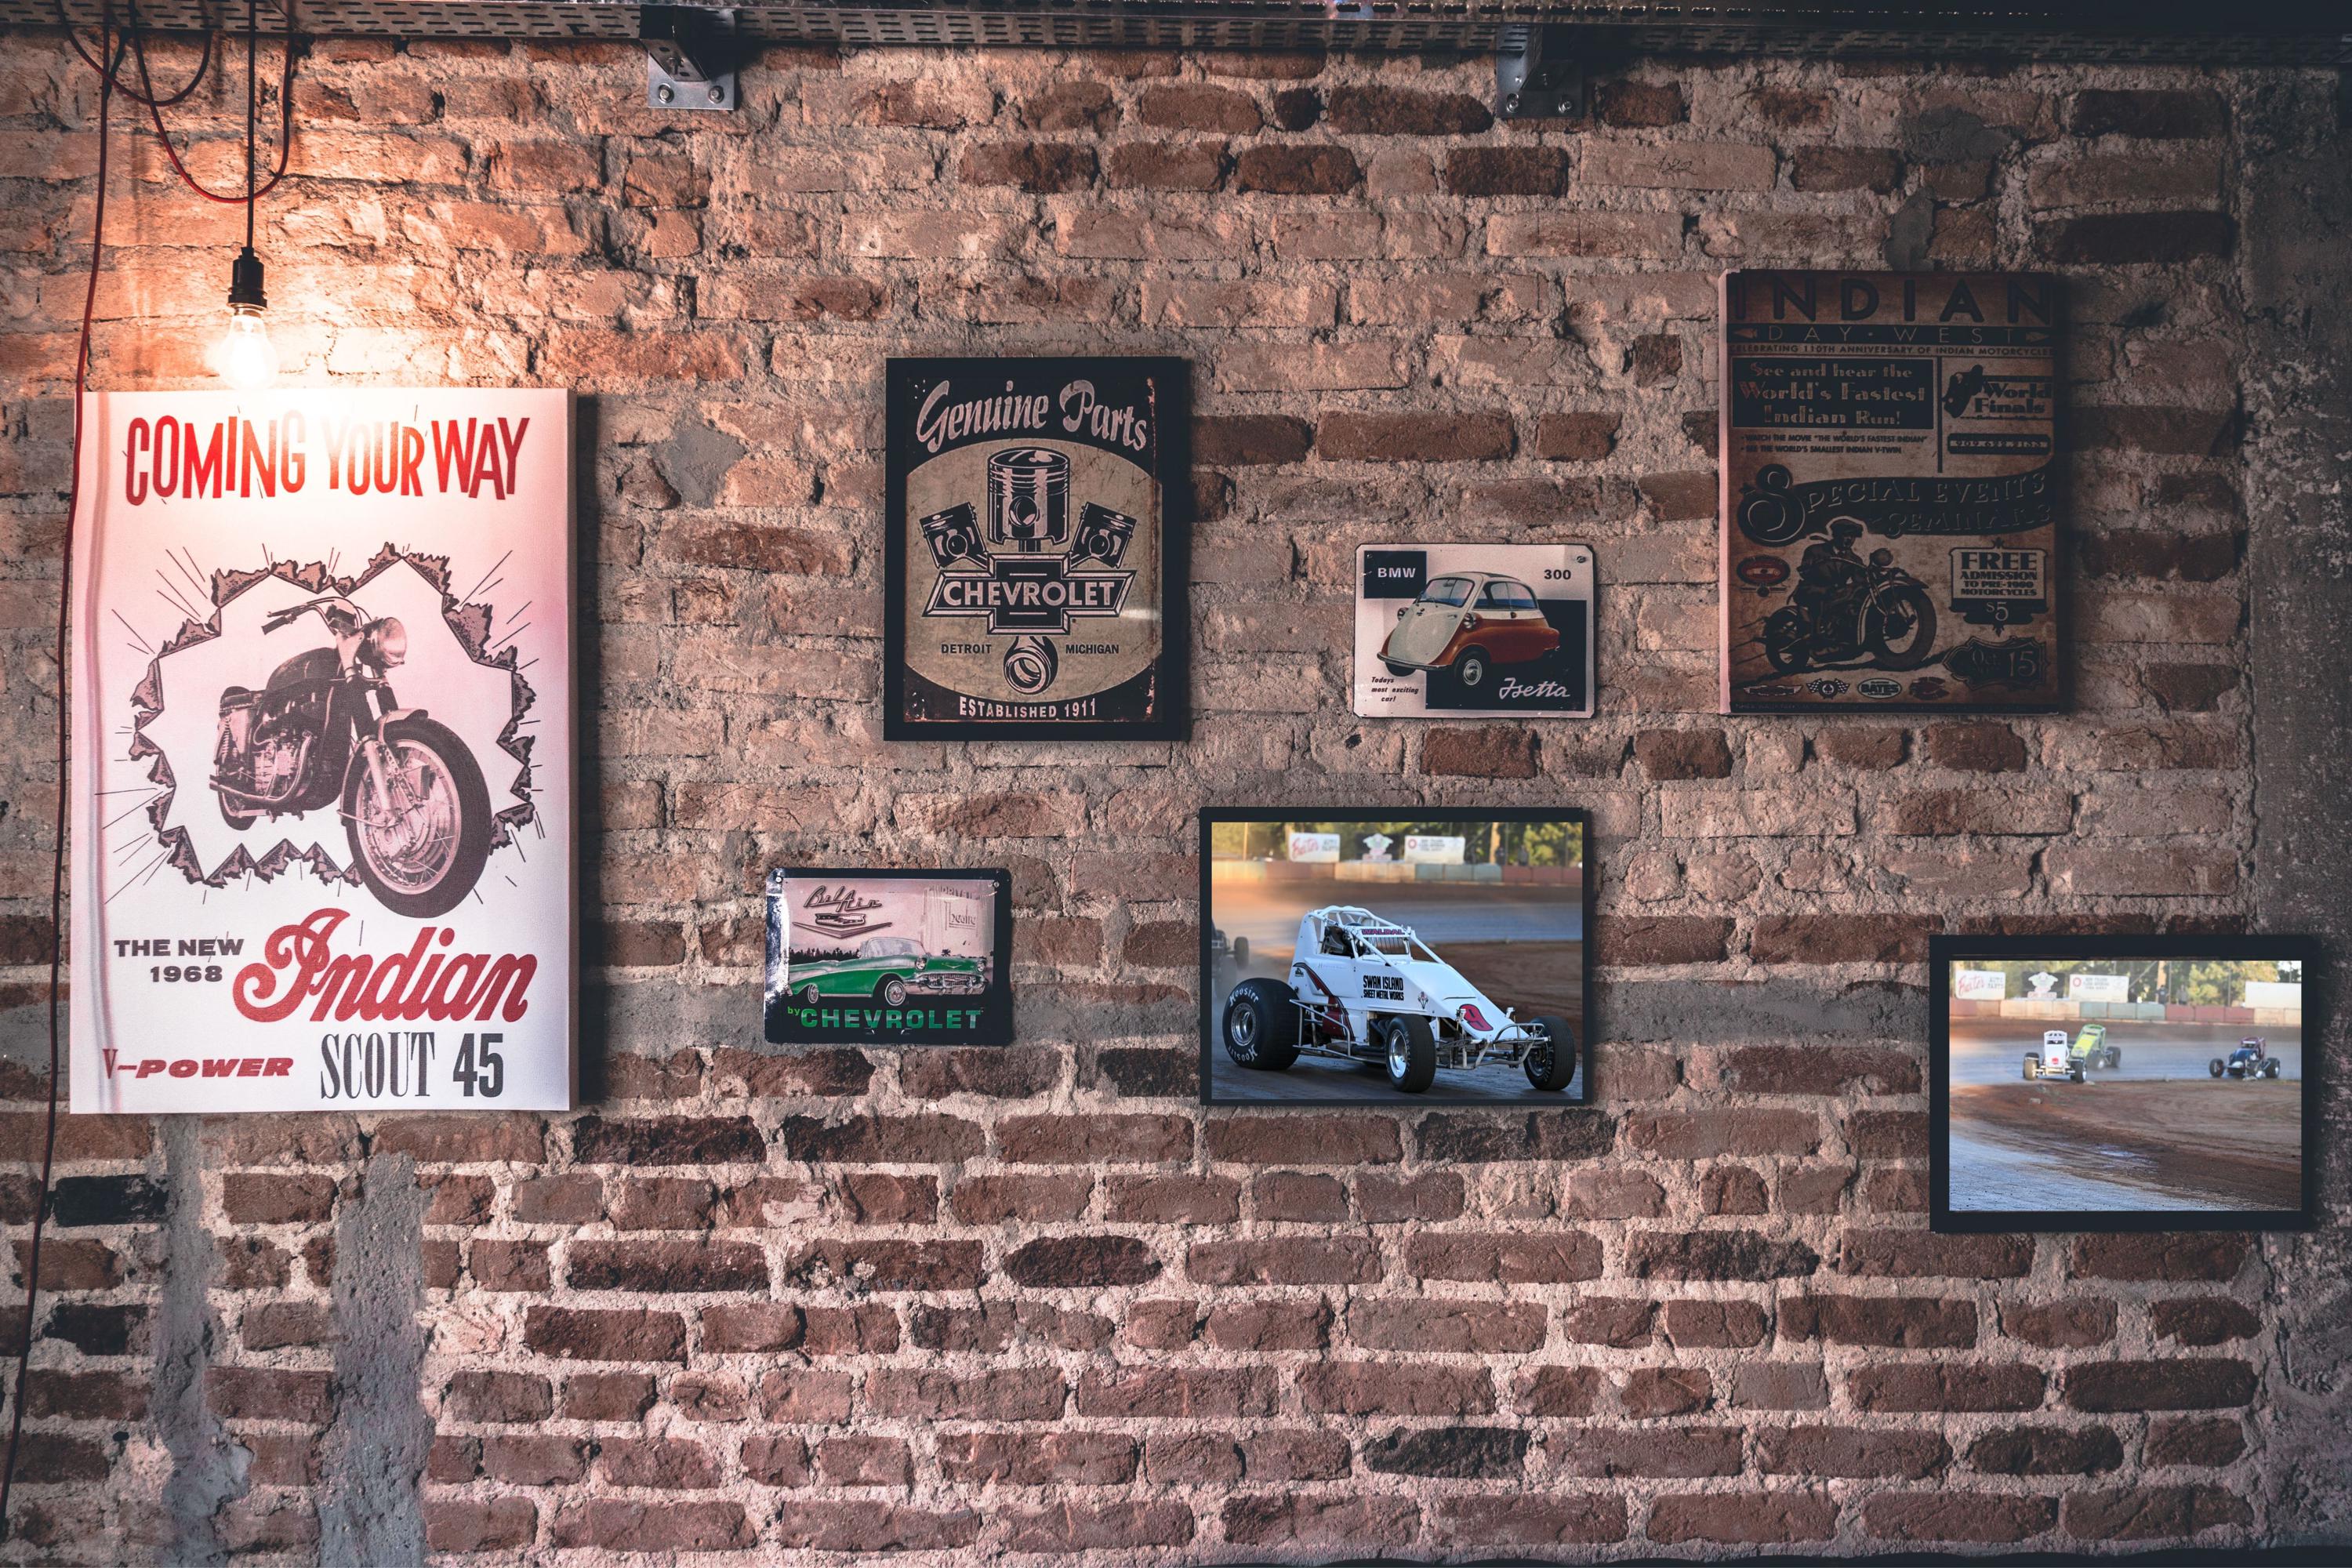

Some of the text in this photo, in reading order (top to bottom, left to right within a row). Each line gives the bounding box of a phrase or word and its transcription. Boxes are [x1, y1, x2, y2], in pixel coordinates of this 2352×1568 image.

[1734, 277, 2053, 323] INDIAN
[1769, 325, 2014, 344] DAY WEST
[1804, 345, 1835, 354] 110TH
[1841, 346, 1913, 354] ANNIVERSARY
[1750, 361, 1913, 378] See and hear the
[1738, 380, 1926, 401] World's Fastest
[1982, 383, 2053, 398] World
[1763, 404, 1901, 426] Indian Run!
[1974, 397, 2045, 413] Finals
[916, 379, 1147, 454] Genuine Parts
[1744, 434, 1771, 442] WATCH
[1773, 434, 1786, 442] THE
[1832, 434, 1865, 443] WORLD'S
[125, 408, 531, 506] COMING YOUR WAY
[1875, 446, 1902, 455] V-TWIN
[1738, 464, 2047, 546] SPECIAL EVENTS
[1888, 503, 2053, 540] SEMINARS
[1960, 551, 2038, 571] FREE
[1377, 567, 1416, 579] BMW
[1543, 568, 1572, 580] 300
[1960, 571, 2038, 581] ADMISSION
[942, 580, 1116, 607] CHEVROLET
[941, 643, 1120, 655] DETROIT MICHIGAN
[2009, 651, 2037, 677] 15
[1392, 686, 1420, 695] exciting
[1498, 677, 1570, 700] Isetta
[959, 695, 1097, 719] ESTABLISHED 1911
[803, 884, 884, 913] Bel Air
[114, 938, 245, 958] THE NEW
[150, 965, 223, 983] 1968
[232, 906, 539, 1023] Indian
[1363, 975, 1404, 991] SWAN ISLAND
[1229, 987, 1259, 1007] Hoosier
[1363, 989, 1405, 1001] SHEET METAL WORKS
[787, 1006, 800, 1017] by
[800, 1008, 982, 1029] CHEVROLET
[102, 1047, 295, 1080] V-POWER
[320, 1031, 504, 1100] SCOUT 45
